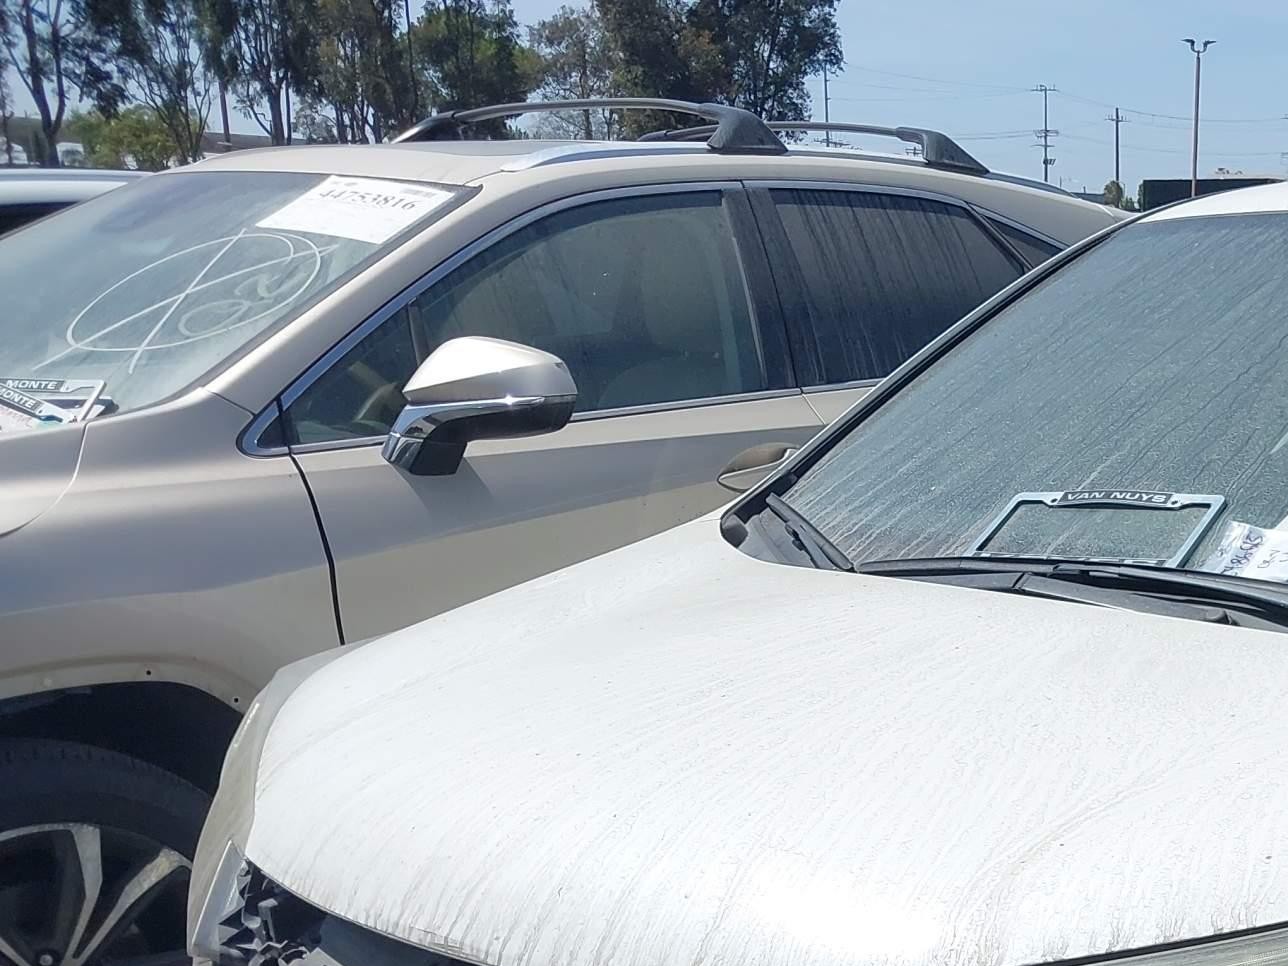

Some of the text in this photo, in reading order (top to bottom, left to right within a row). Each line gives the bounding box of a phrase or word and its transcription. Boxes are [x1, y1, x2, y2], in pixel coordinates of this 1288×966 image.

[6, 380, 58, 390] MONTE
[1066, 491, 1167, 503] VAN NUYS
